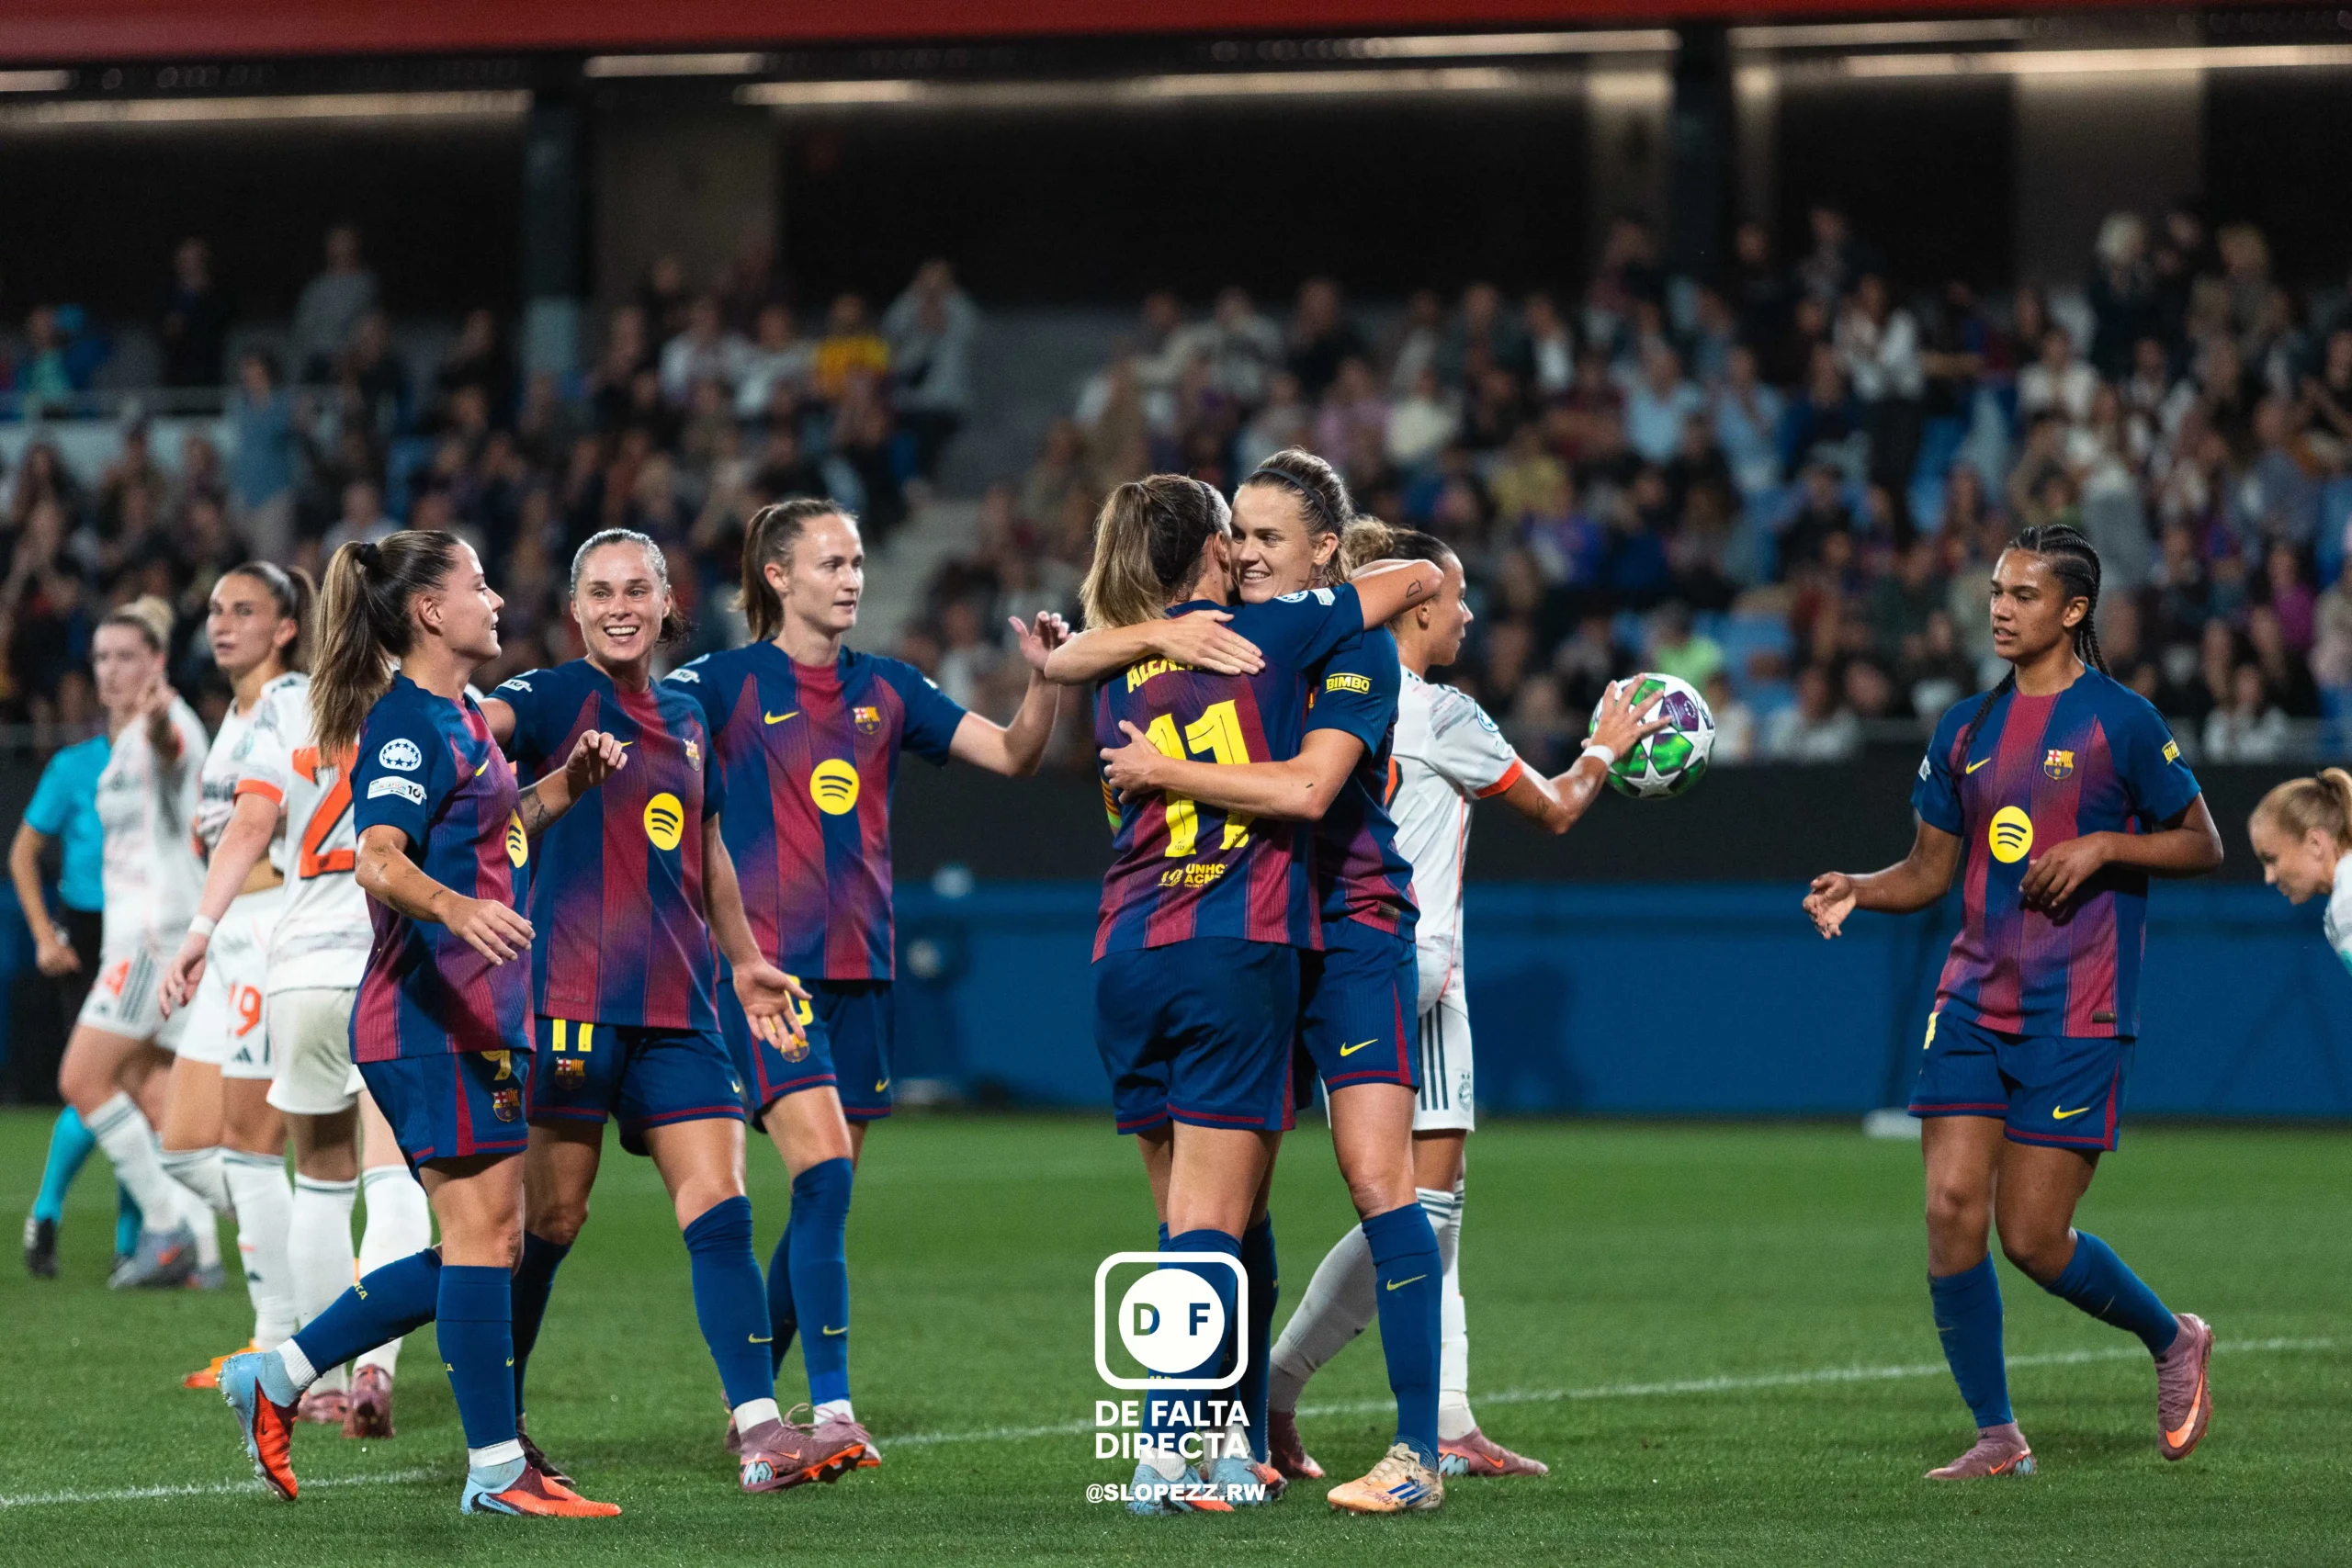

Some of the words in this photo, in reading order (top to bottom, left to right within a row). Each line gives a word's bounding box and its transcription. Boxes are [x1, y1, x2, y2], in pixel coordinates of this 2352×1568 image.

[1326, 676, 1371, 693] BIMBO
[1144, 699, 1254, 857] 11
[1185, 863, 1228, 874] UNHC
